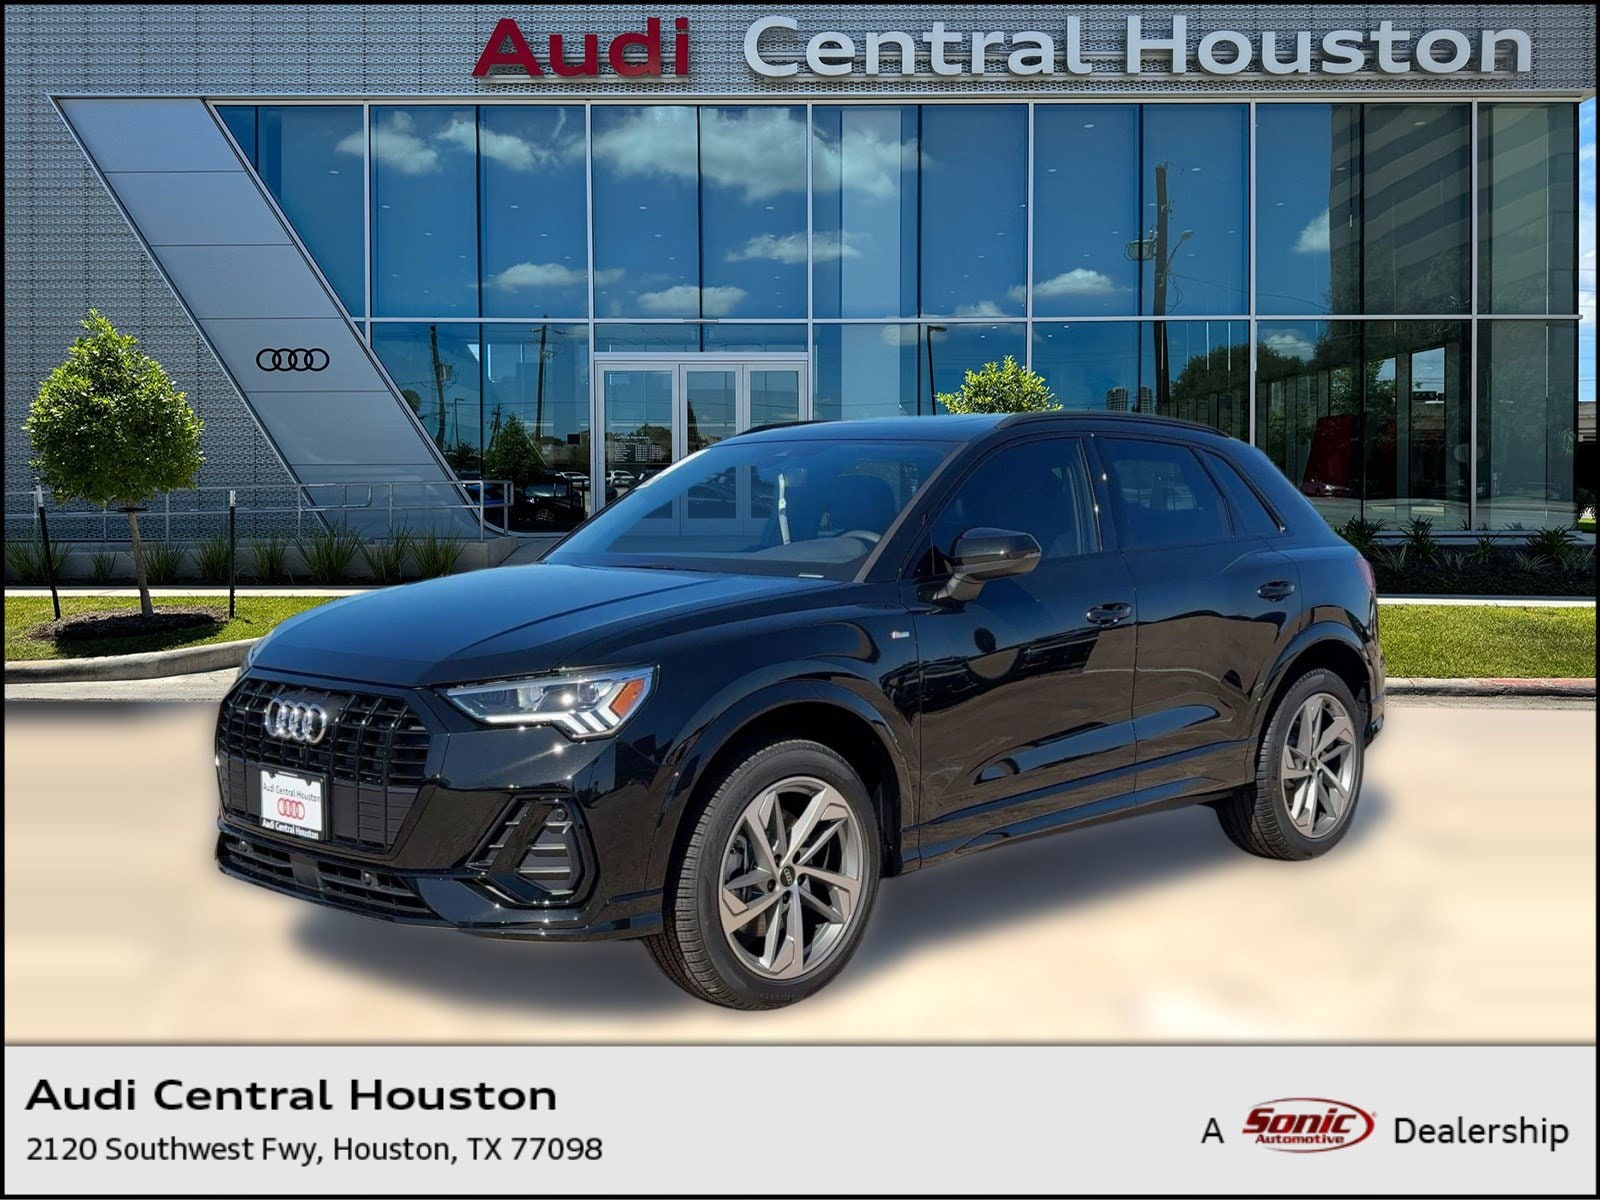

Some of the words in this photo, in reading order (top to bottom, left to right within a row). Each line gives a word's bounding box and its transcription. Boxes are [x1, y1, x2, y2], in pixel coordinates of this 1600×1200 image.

[471, 17, 689, 77] Audi
[744, 15, 1093, 77] Central
[1127, 15, 1532, 75] Houston
[263, 782, 275, 793] Audi
[276, 785, 296, 798] Central
[297, 789, 321, 803] Houston
[262, 818, 275, 830] Audi
[275, 822, 296, 836] Central
[296, 826, 319, 841] Houston
